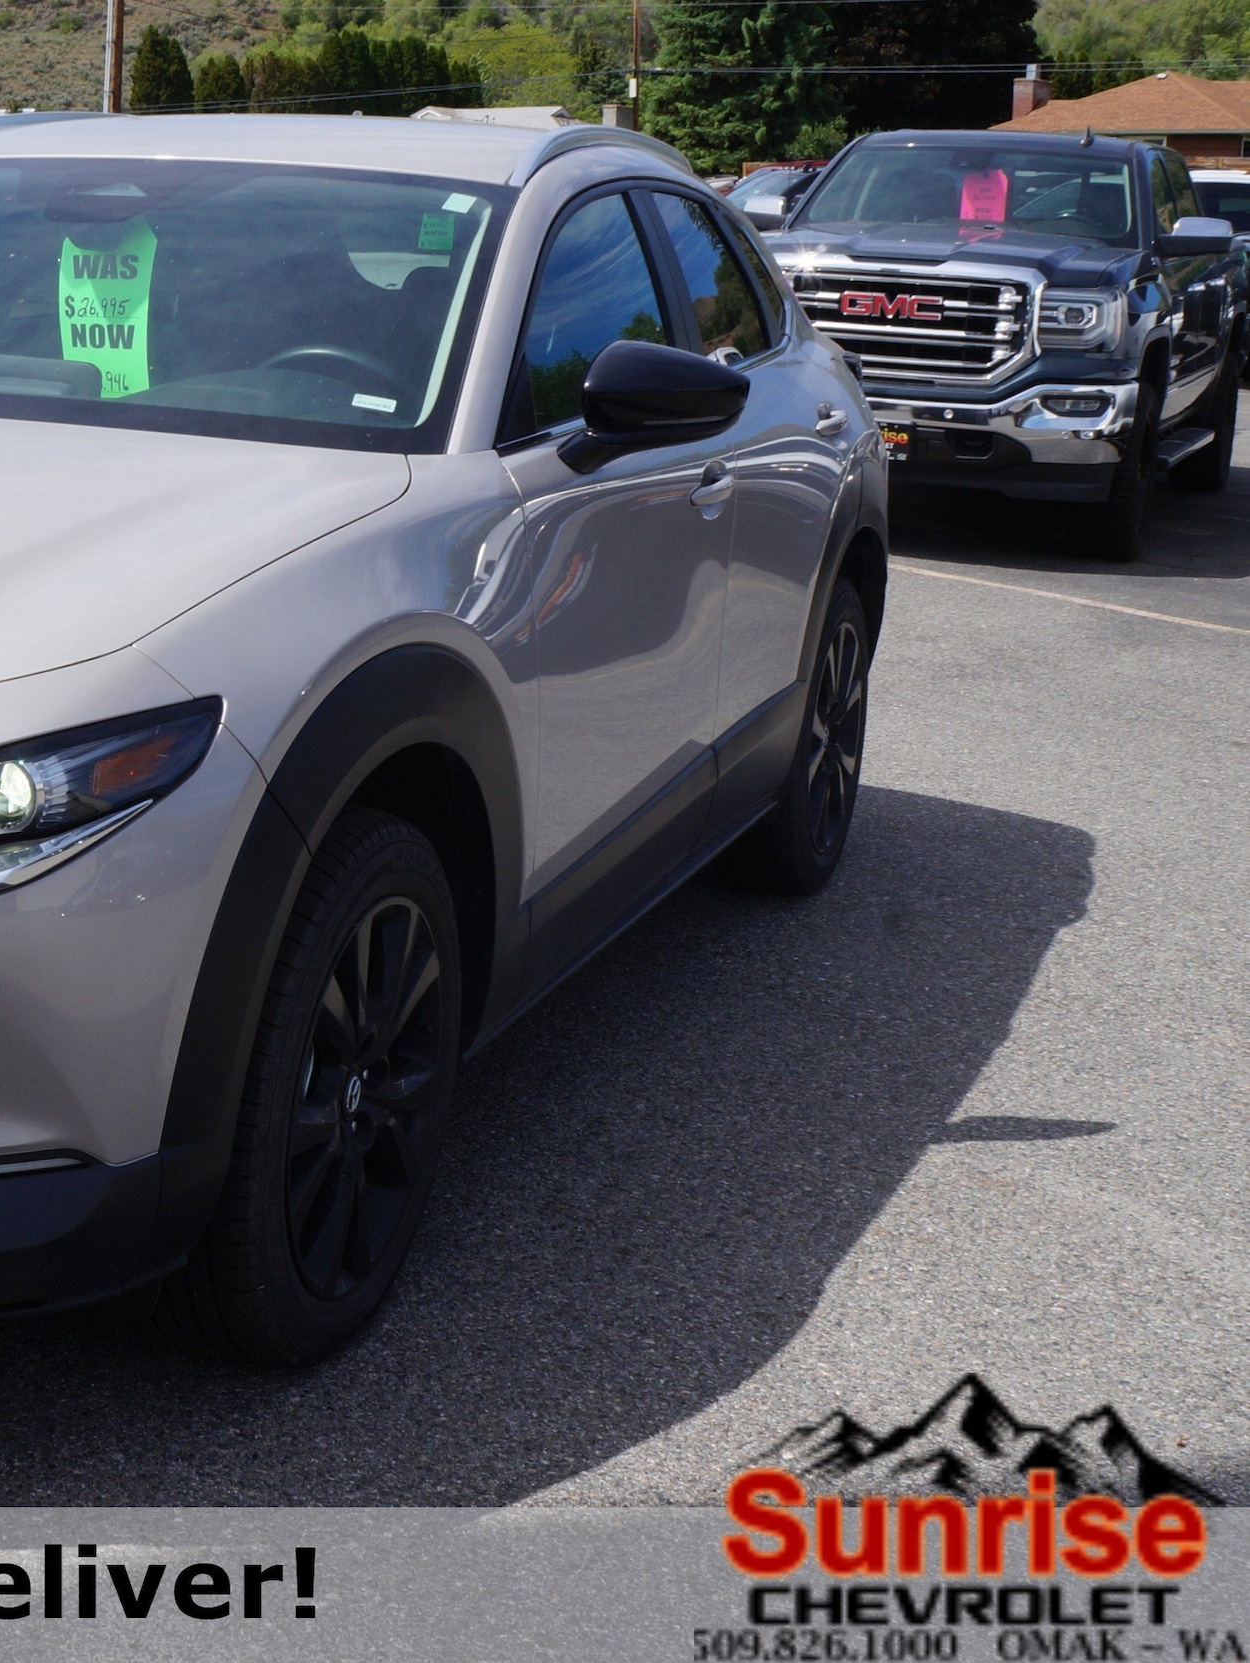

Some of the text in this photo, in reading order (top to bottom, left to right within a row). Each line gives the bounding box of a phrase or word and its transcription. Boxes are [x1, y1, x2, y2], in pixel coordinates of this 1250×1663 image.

[72, 254, 139, 280] WAS
[840, 291, 944, 321] GMC
[70, 324, 135, 350] NOW
